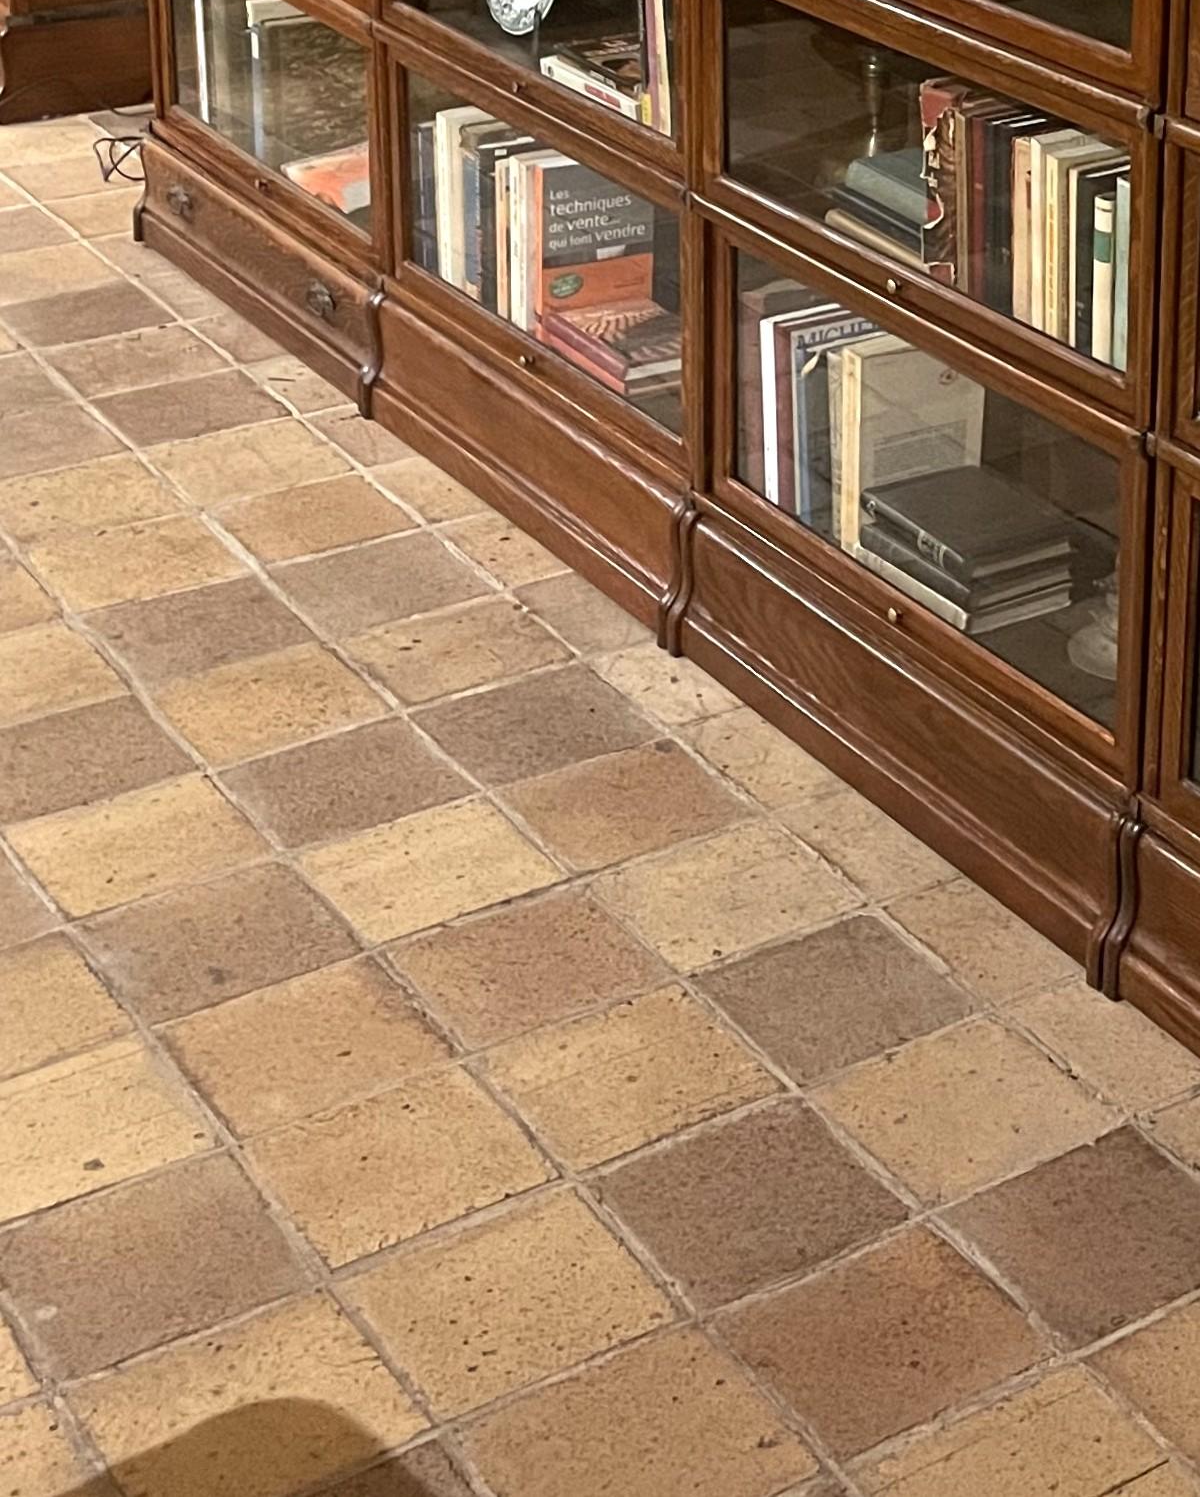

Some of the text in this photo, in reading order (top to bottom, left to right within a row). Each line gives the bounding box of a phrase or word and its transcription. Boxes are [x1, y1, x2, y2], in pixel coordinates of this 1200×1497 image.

[549, 189, 570, 201] Les
[549, 193, 633, 217] techniques
[548, 222, 565, 234] de
[594, 223, 646, 242] vendre
[548, 238, 568, 251] qui
